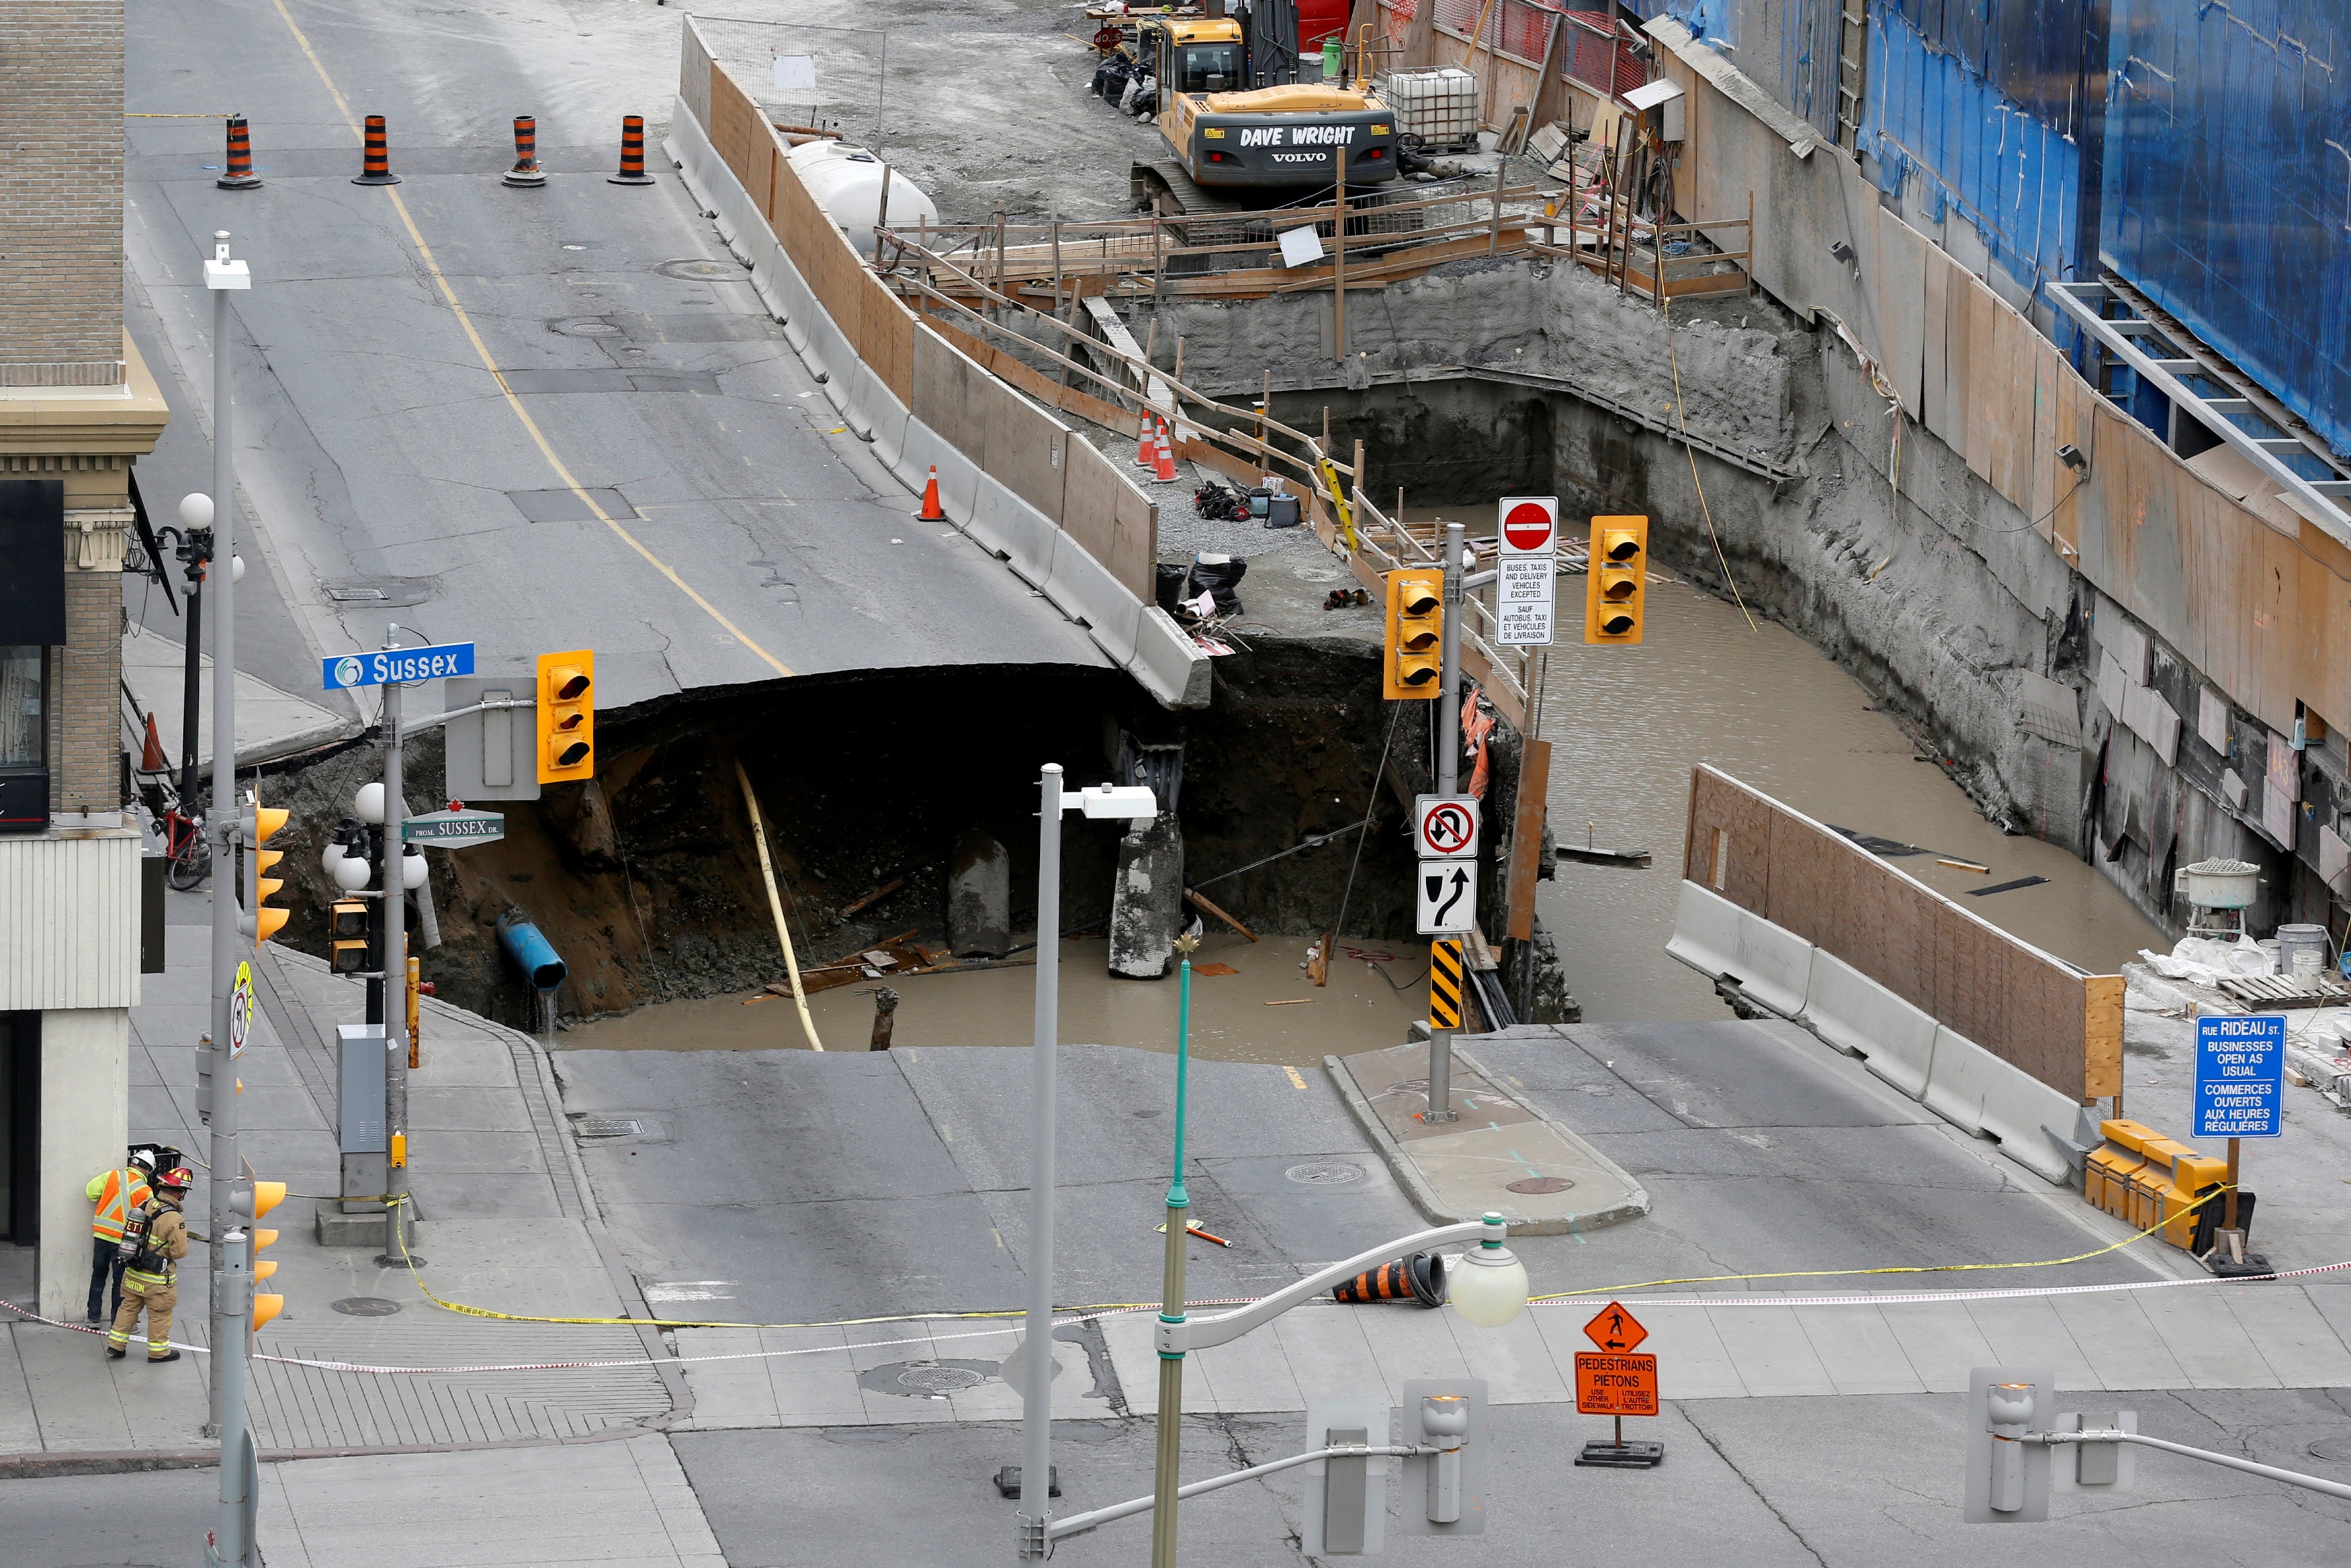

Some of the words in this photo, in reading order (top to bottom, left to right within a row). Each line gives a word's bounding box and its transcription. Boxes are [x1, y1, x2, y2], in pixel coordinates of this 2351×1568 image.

[1240, 128, 1284, 146] DAVE
[1292, 126, 1356, 145] WRIGHT
[1272, 152, 1327, 163] VOLVO
[1507, 564, 1528, 572] BUSES,
[1514, 631, 1545, 639] LIVRAISON
[373, 653, 458, 683] Sussex
[439, 821, 486, 835] SUSSEX
[2202, 1027, 2218, 1035] RUE
[2221, 1021, 2266, 1035] RIDEAU
[2268, 1026, 2280, 1035] ST.
[2207, 1041, 2273, 1052] BUSINESSES
[2217, 1054, 2246, 1064] OPEN
[2248, 1054, 2263, 1064] AS
[2222, 1066, 2257, 1076] USUAL
[2205, 1085, 2272, 1095] COMMERCES
[2214, 1097, 2262, 1107] OUVERTS
[2205, 1109, 2225, 1119] AUX
[2229, 1109, 2270, 1119] HEURES
[126, 1220, 144, 1232] ETY
[125, 1278, 145, 1293] BARTON
[463, 1306, 472, 1314] LINE
[478, 1309, 486, 1317] NOT
[1579, 1358, 1653, 1372] PEDESTRIANS
[1594, 1372, 1640, 1387] PIÉTONS
